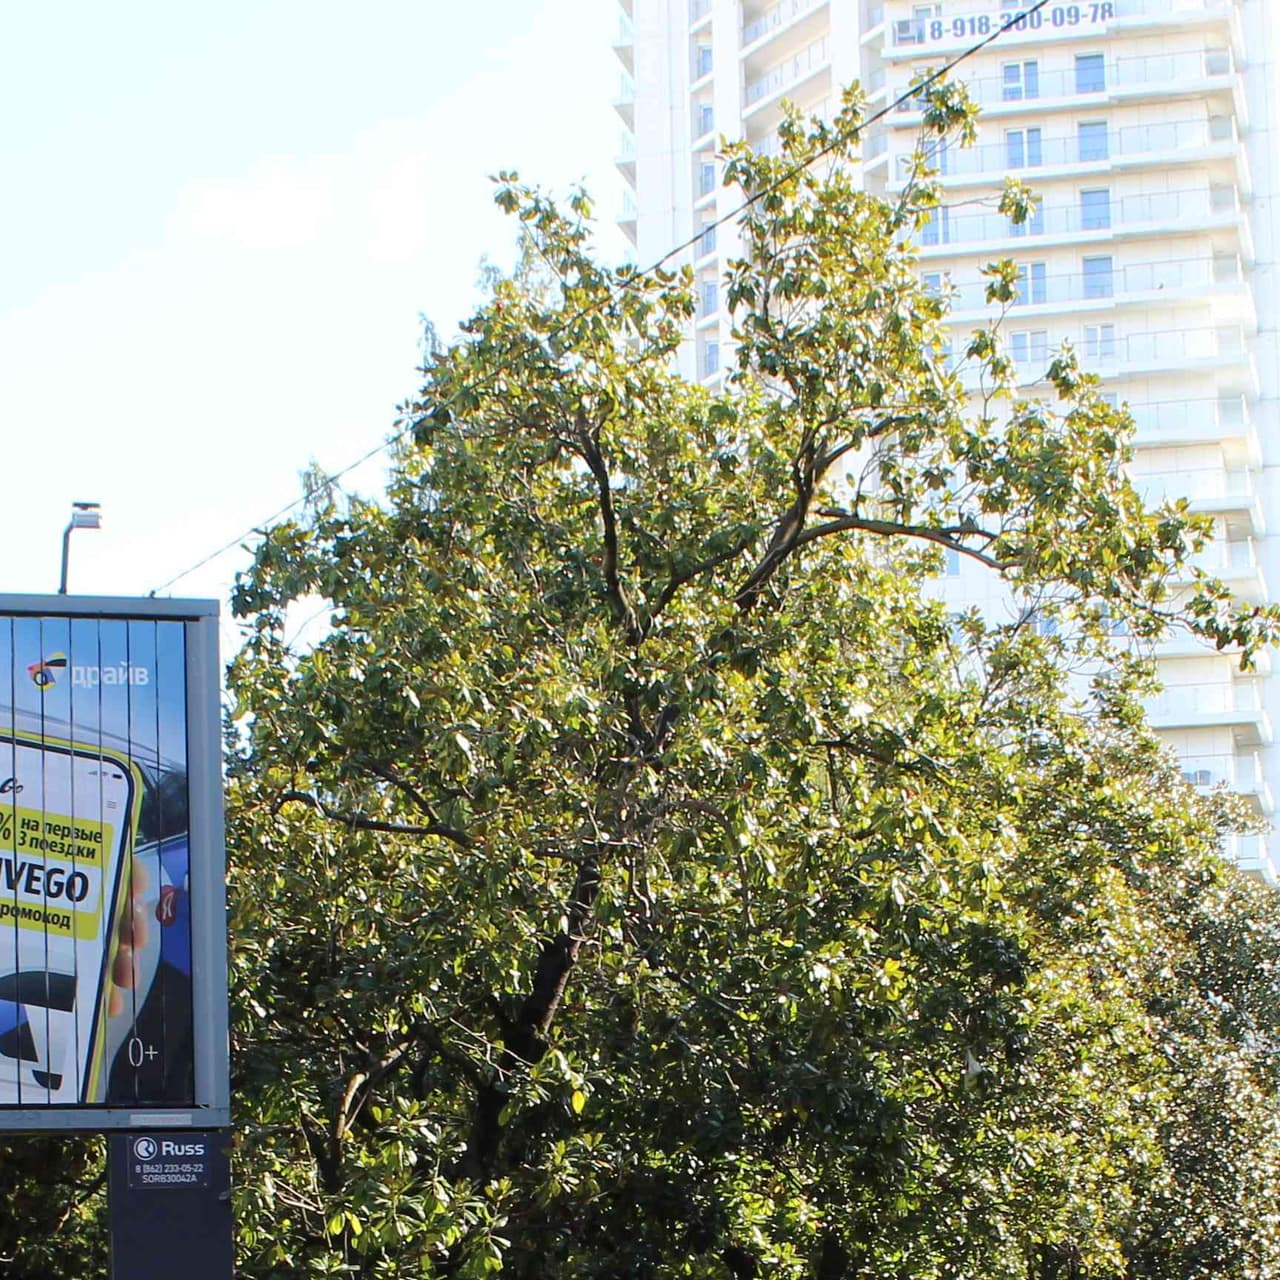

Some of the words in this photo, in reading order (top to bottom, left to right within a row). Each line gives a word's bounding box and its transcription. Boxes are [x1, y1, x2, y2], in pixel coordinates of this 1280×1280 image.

[71, 660, 150, 688] драйв
[0, 777, 24, 795] Go
[20, 816, 40, 832] на
[43, 821, 103, 844] первые
[17, 830, 27, 848] 3
[29, 834, 97, 859] поездки
[128, 1036, 159, 1067] 0+
[161, 1141, 205, 1156] Russ
